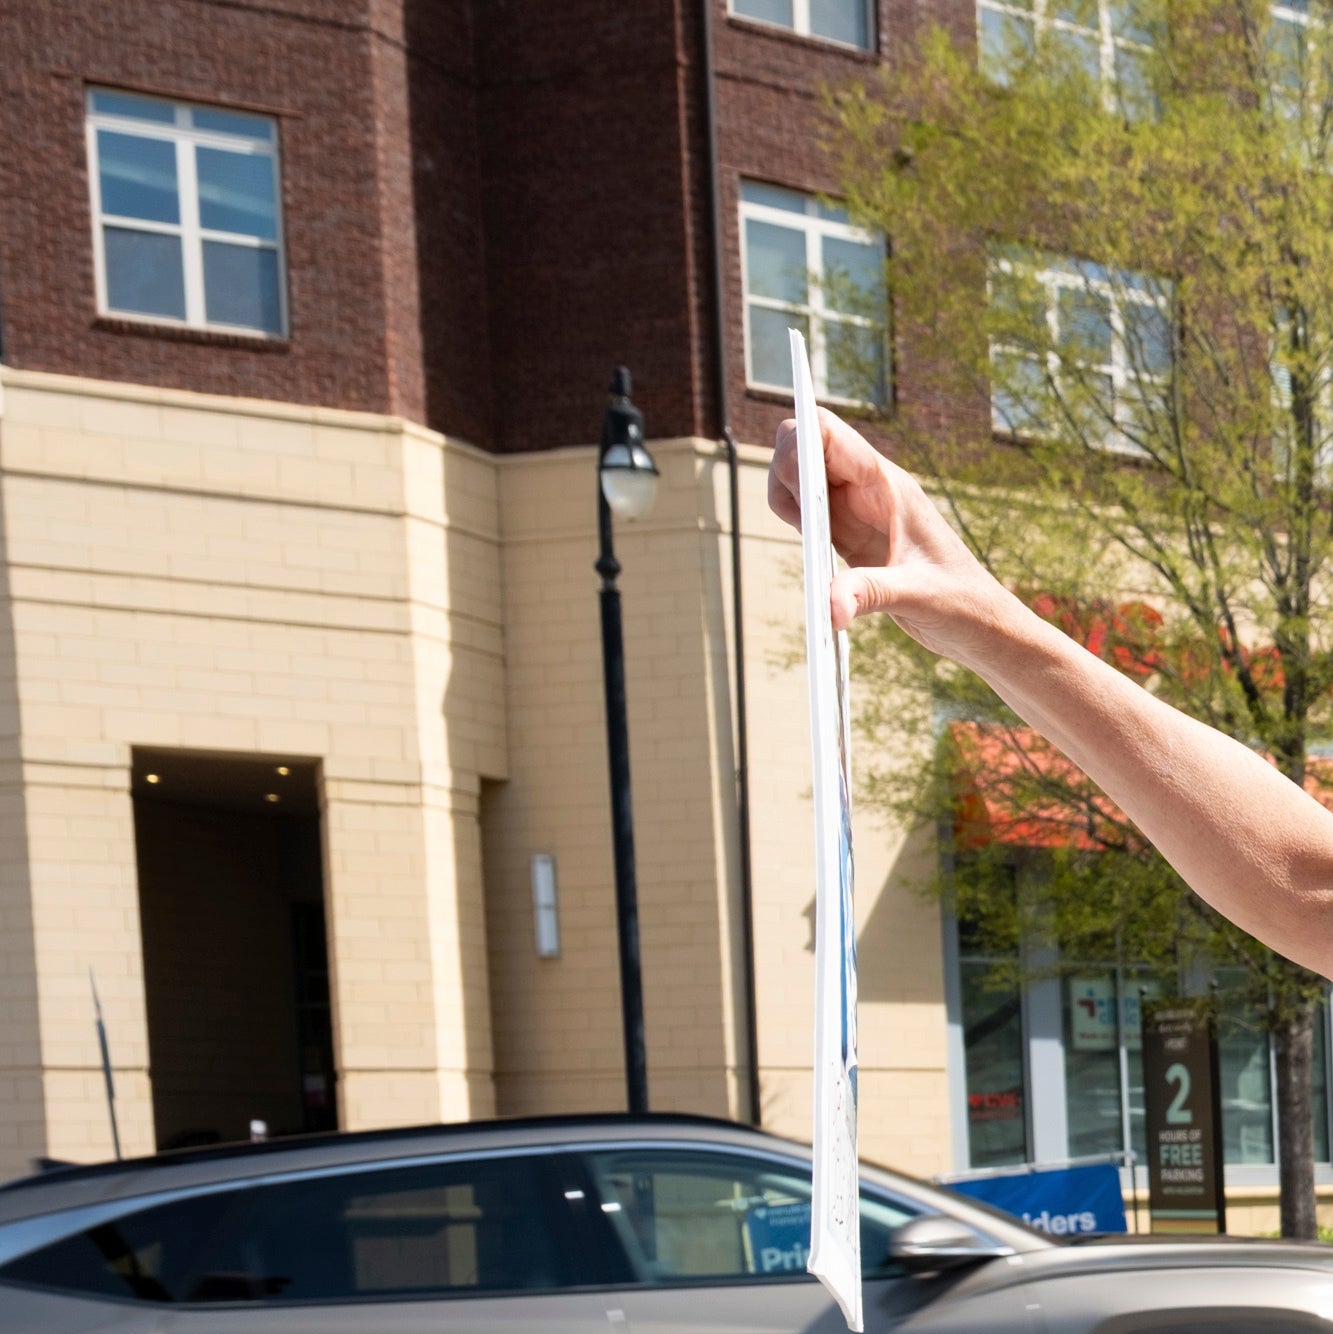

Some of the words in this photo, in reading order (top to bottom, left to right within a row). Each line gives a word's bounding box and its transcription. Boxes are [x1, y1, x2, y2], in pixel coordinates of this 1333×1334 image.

[1165, 1062, 1193, 1124] 2
[1158, 1129, 1188, 1143] HOURS
[1189, 1129, 1202, 1142] OF
[1160, 1143, 1203, 1167] FREE
[1160, 1168, 1204, 1183] PARKING
